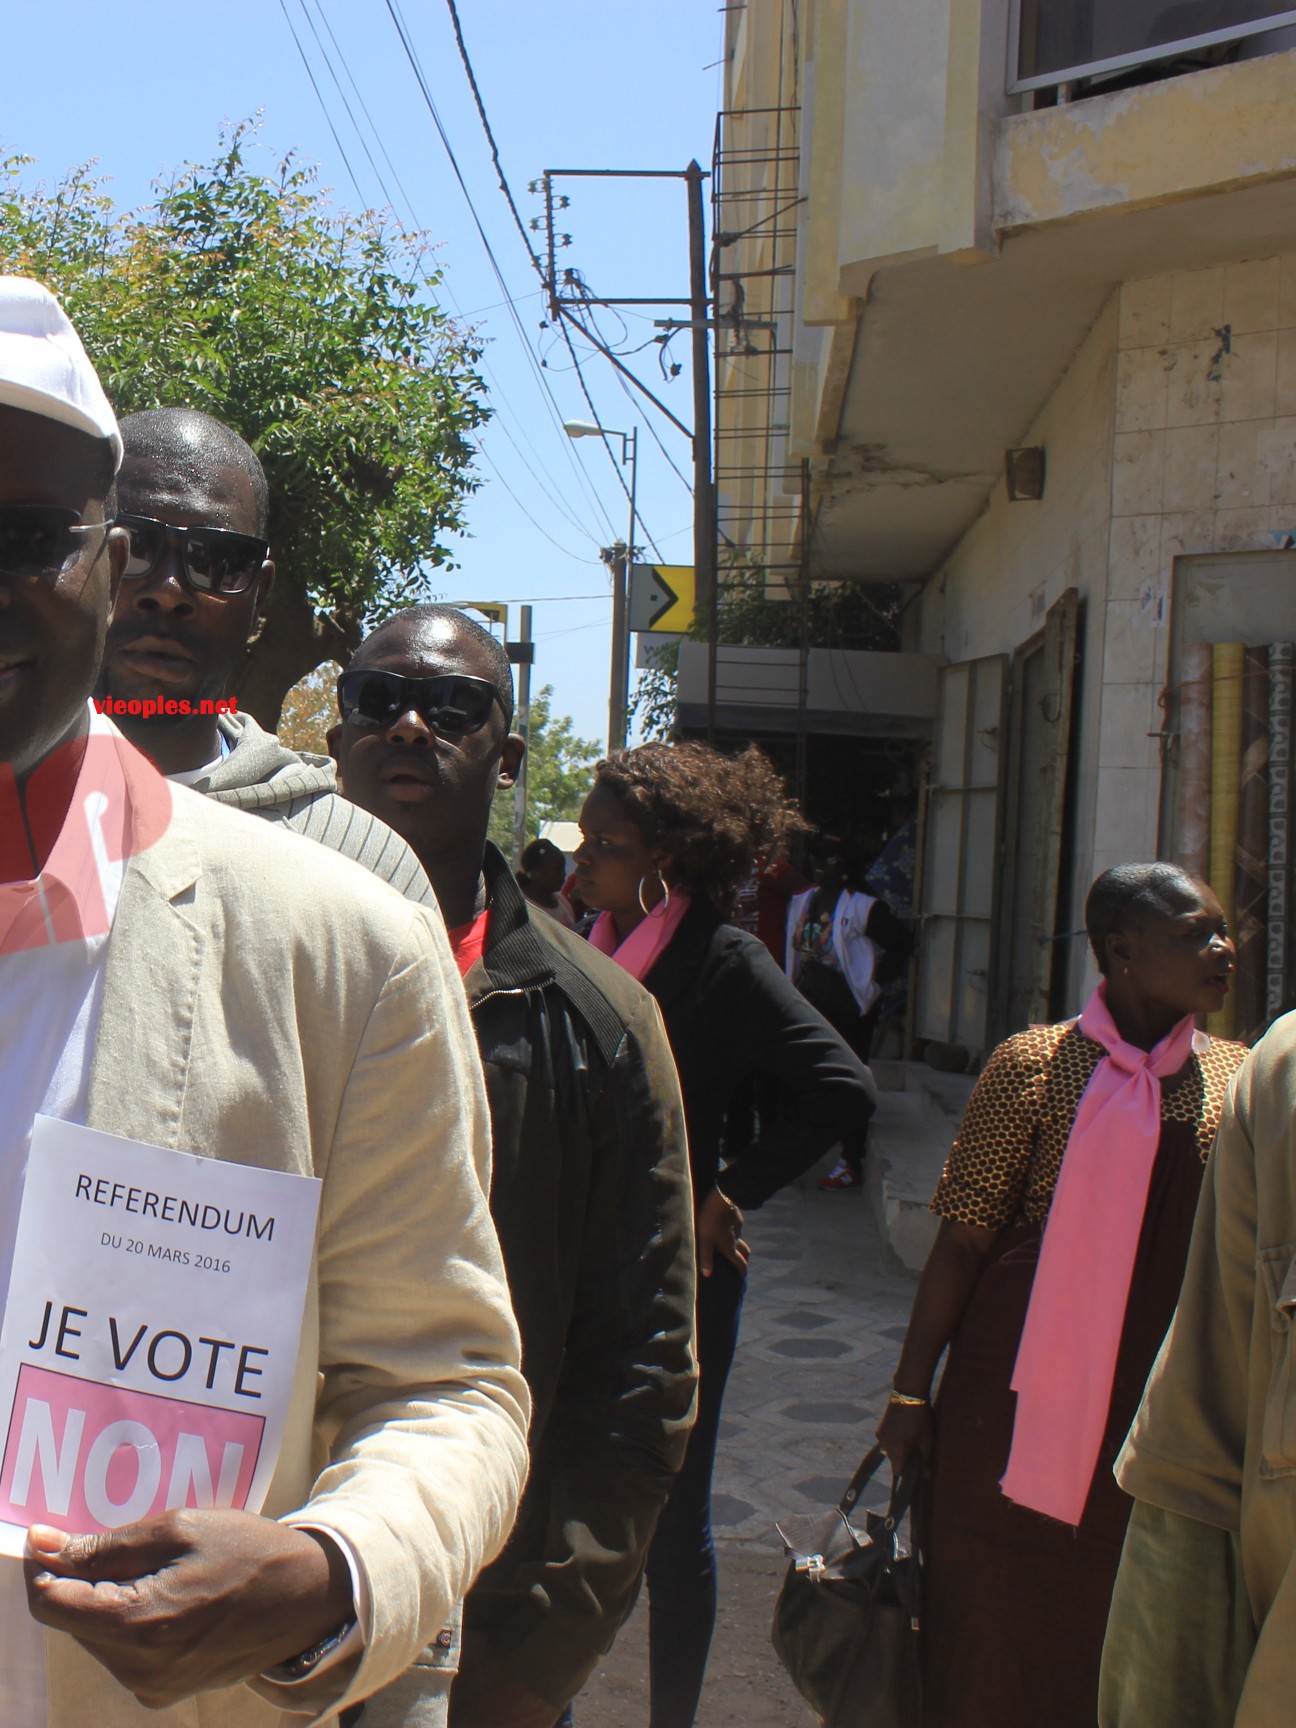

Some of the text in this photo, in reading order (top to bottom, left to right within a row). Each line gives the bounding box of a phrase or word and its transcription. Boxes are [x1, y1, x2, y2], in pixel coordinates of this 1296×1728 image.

[75, 1174, 275, 1241] REFERENDUM
[100, 1232, 231, 1273] DU 20 MARS 2016
[29, 1301, 269, 1399] JE VOTE
[9, 1397, 244, 1528] NON
